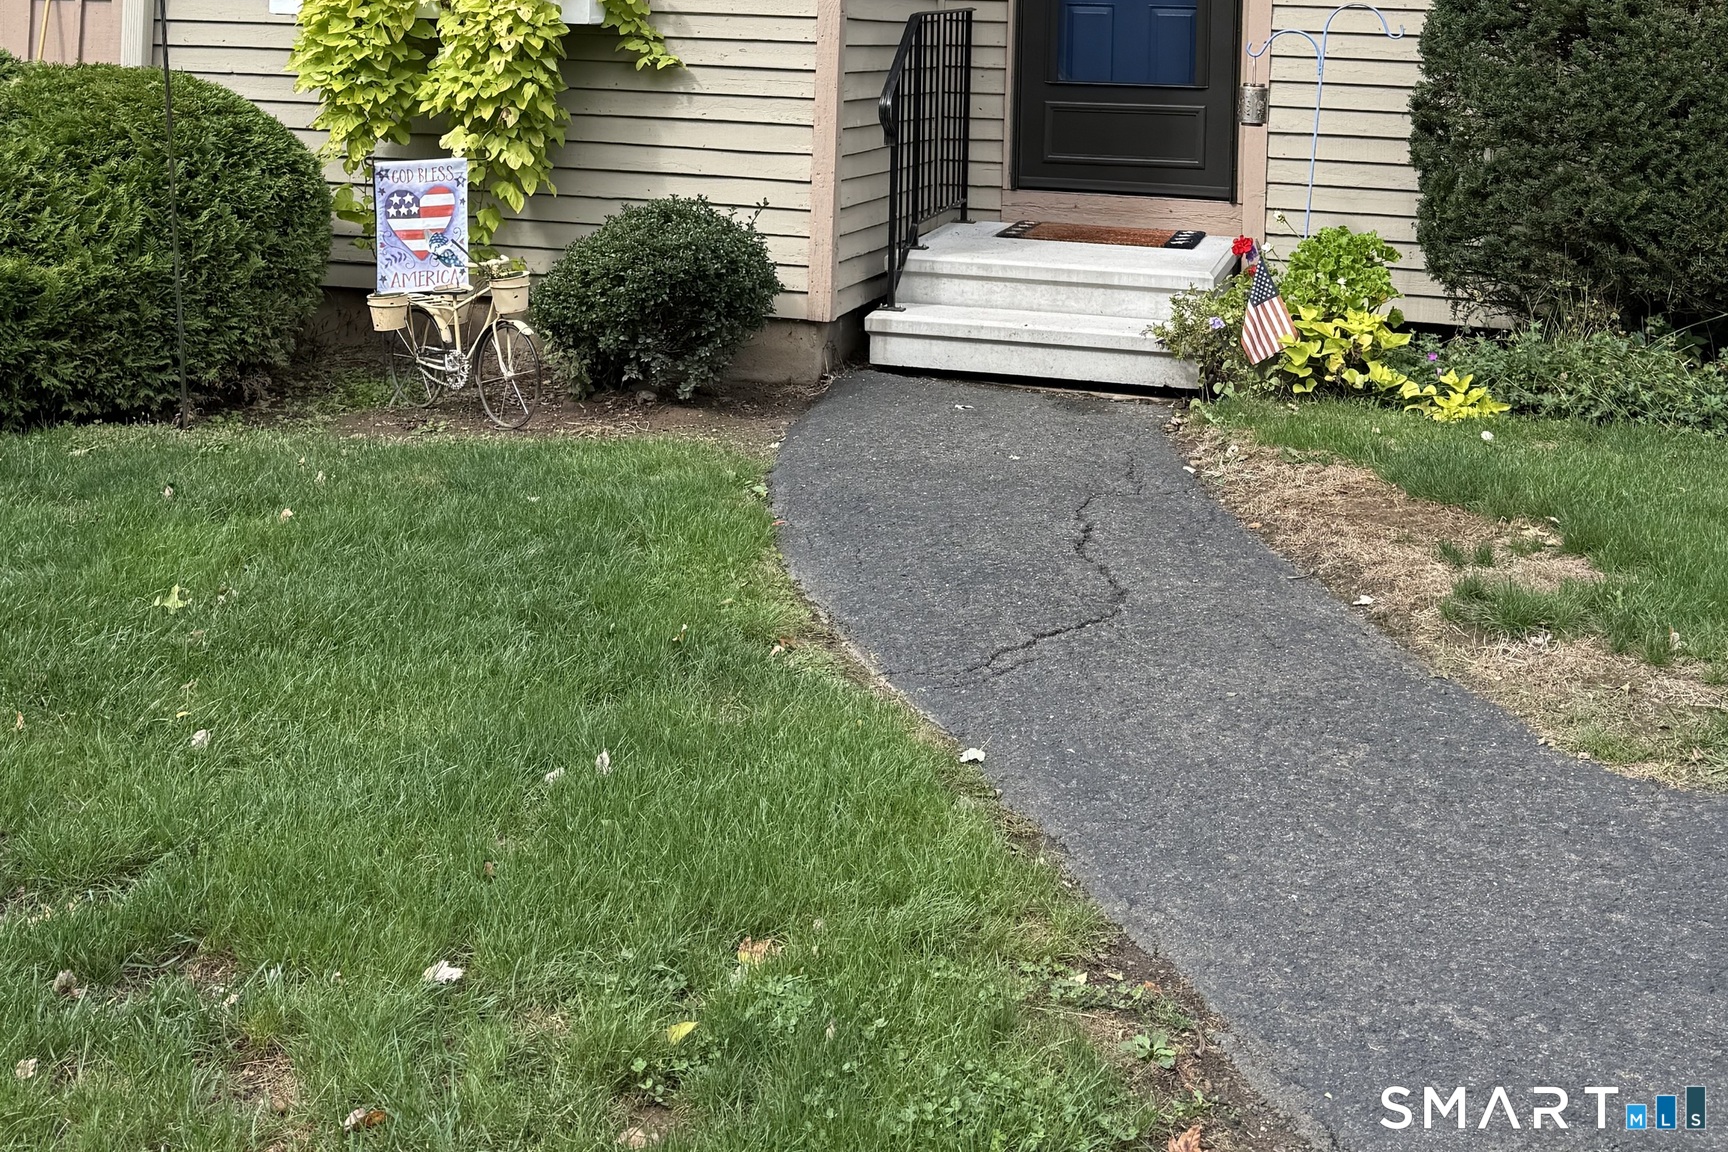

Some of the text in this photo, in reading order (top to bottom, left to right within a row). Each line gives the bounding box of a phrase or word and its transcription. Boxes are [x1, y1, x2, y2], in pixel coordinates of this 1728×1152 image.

[391, 165, 455, 184] GOD BLESS
[390, 268, 460, 288] AMERICA
